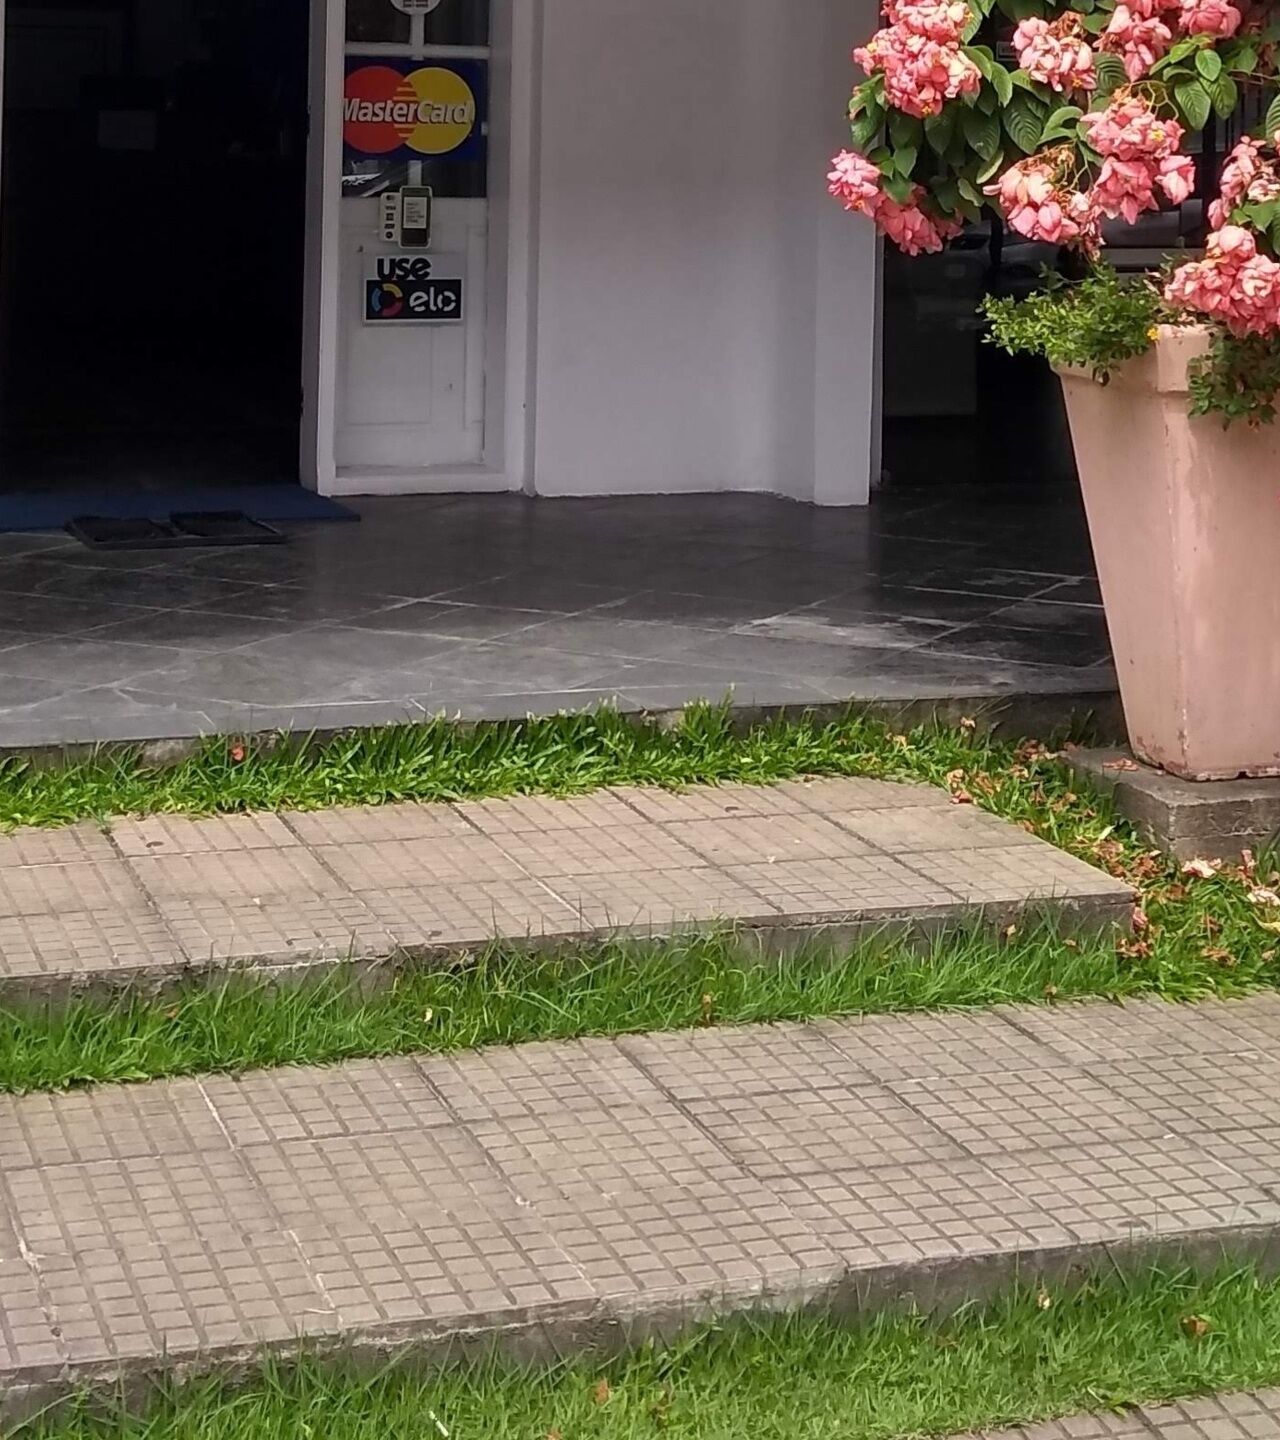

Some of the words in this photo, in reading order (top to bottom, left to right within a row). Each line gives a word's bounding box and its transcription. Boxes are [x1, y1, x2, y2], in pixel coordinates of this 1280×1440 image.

[342, 98, 469, 125] MasterCard
[377, 257, 432, 281] use
[409, 286, 457, 312] elo
